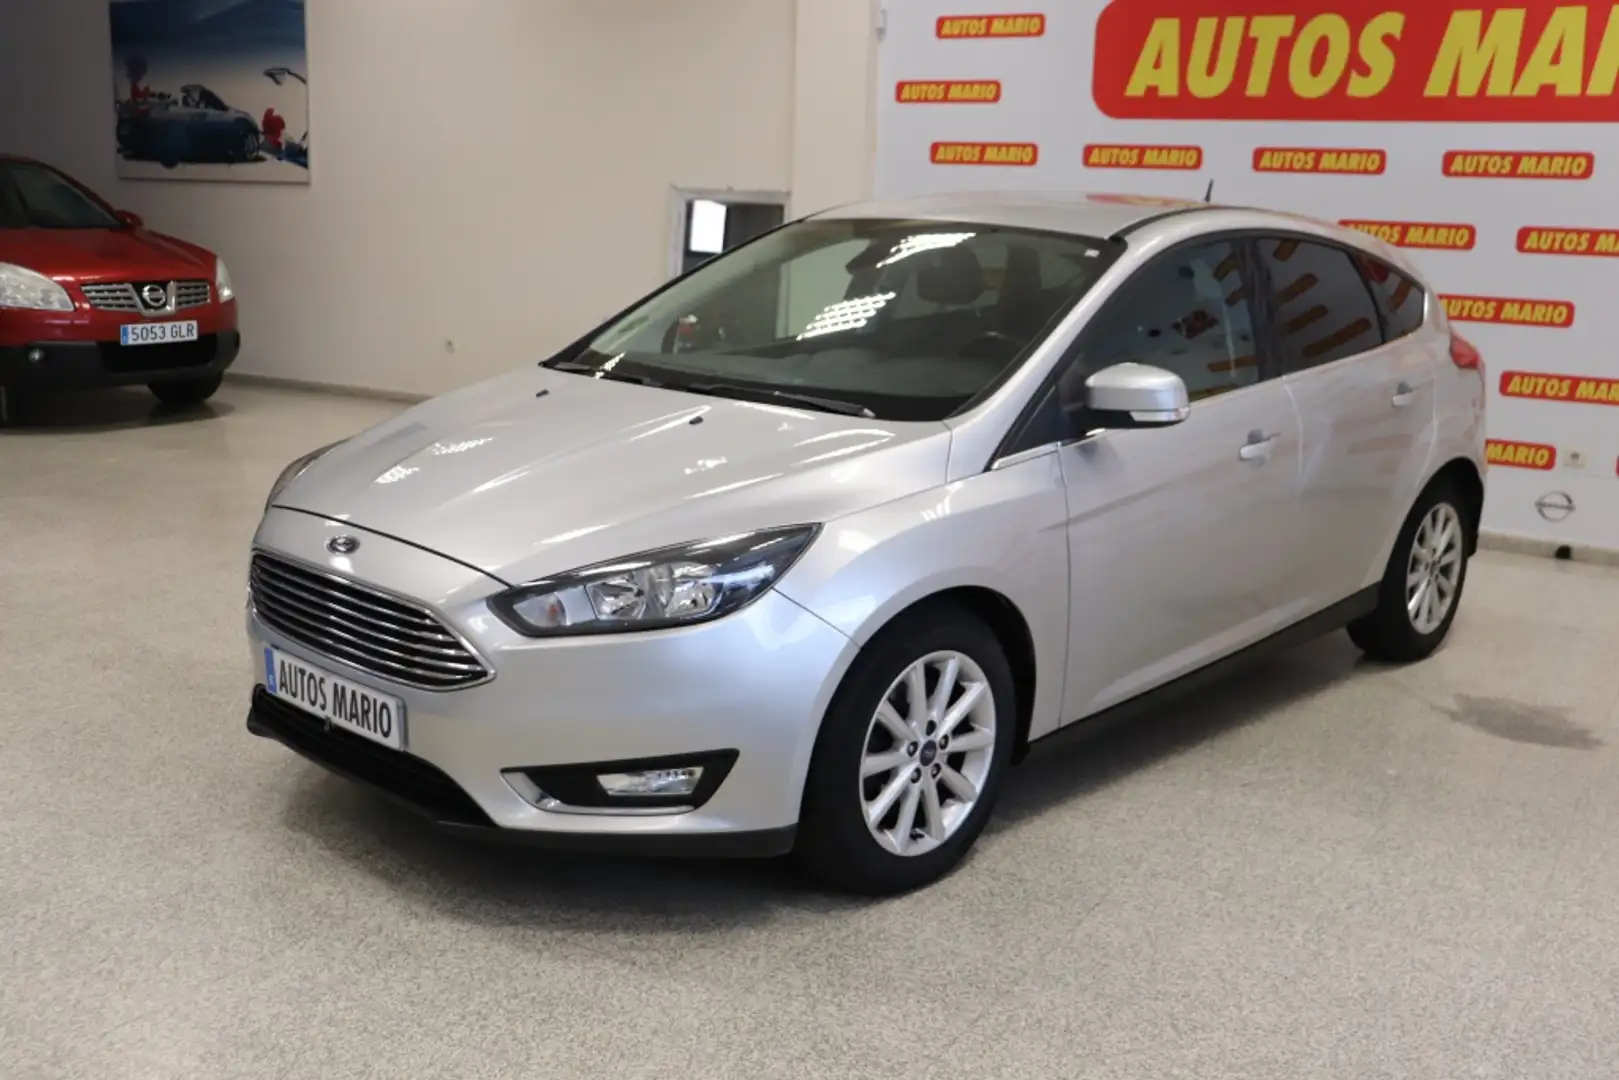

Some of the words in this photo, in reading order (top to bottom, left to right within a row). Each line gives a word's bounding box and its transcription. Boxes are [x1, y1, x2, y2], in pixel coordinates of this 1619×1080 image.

[940, 18, 987, 37] AUTOS
[989, 16, 1041, 34] MARIO
[1125, 12, 1406, 99] AUTOS
[901, 83, 945, 100] AUTOS
[947, 83, 998, 100] MARIO
[935, 145, 980, 162] AUTOS
[983, 146, 1034, 163] MARIO
[1088, 147, 1140, 165] AUTOS
[1142, 148, 1198, 167] MARIO
[1259, 151, 1316, 170] AUTOS
[1318, 152, 1380, 172] MARIO
[1450, 154, 1513, 174] AUTOS
[1516, 155, 1587, 176] MARIO
[1404, 225, 1470, 247] MARIO
[1524, 230, 1590, 252] AUTOS
[1594, 233, 1619, 253] M
[1499, 301, 1568, 324] MARIO
[131, 325, 166, 341] 5053
[170, 323, 195, 338] GLR
[1507, 375, 1572, 397] AUTOS
[1486, 443, 1550, 466] MARIO
[279, 659, 327, 711] AUTOS
[332, 681, 392, 738] MARIO
